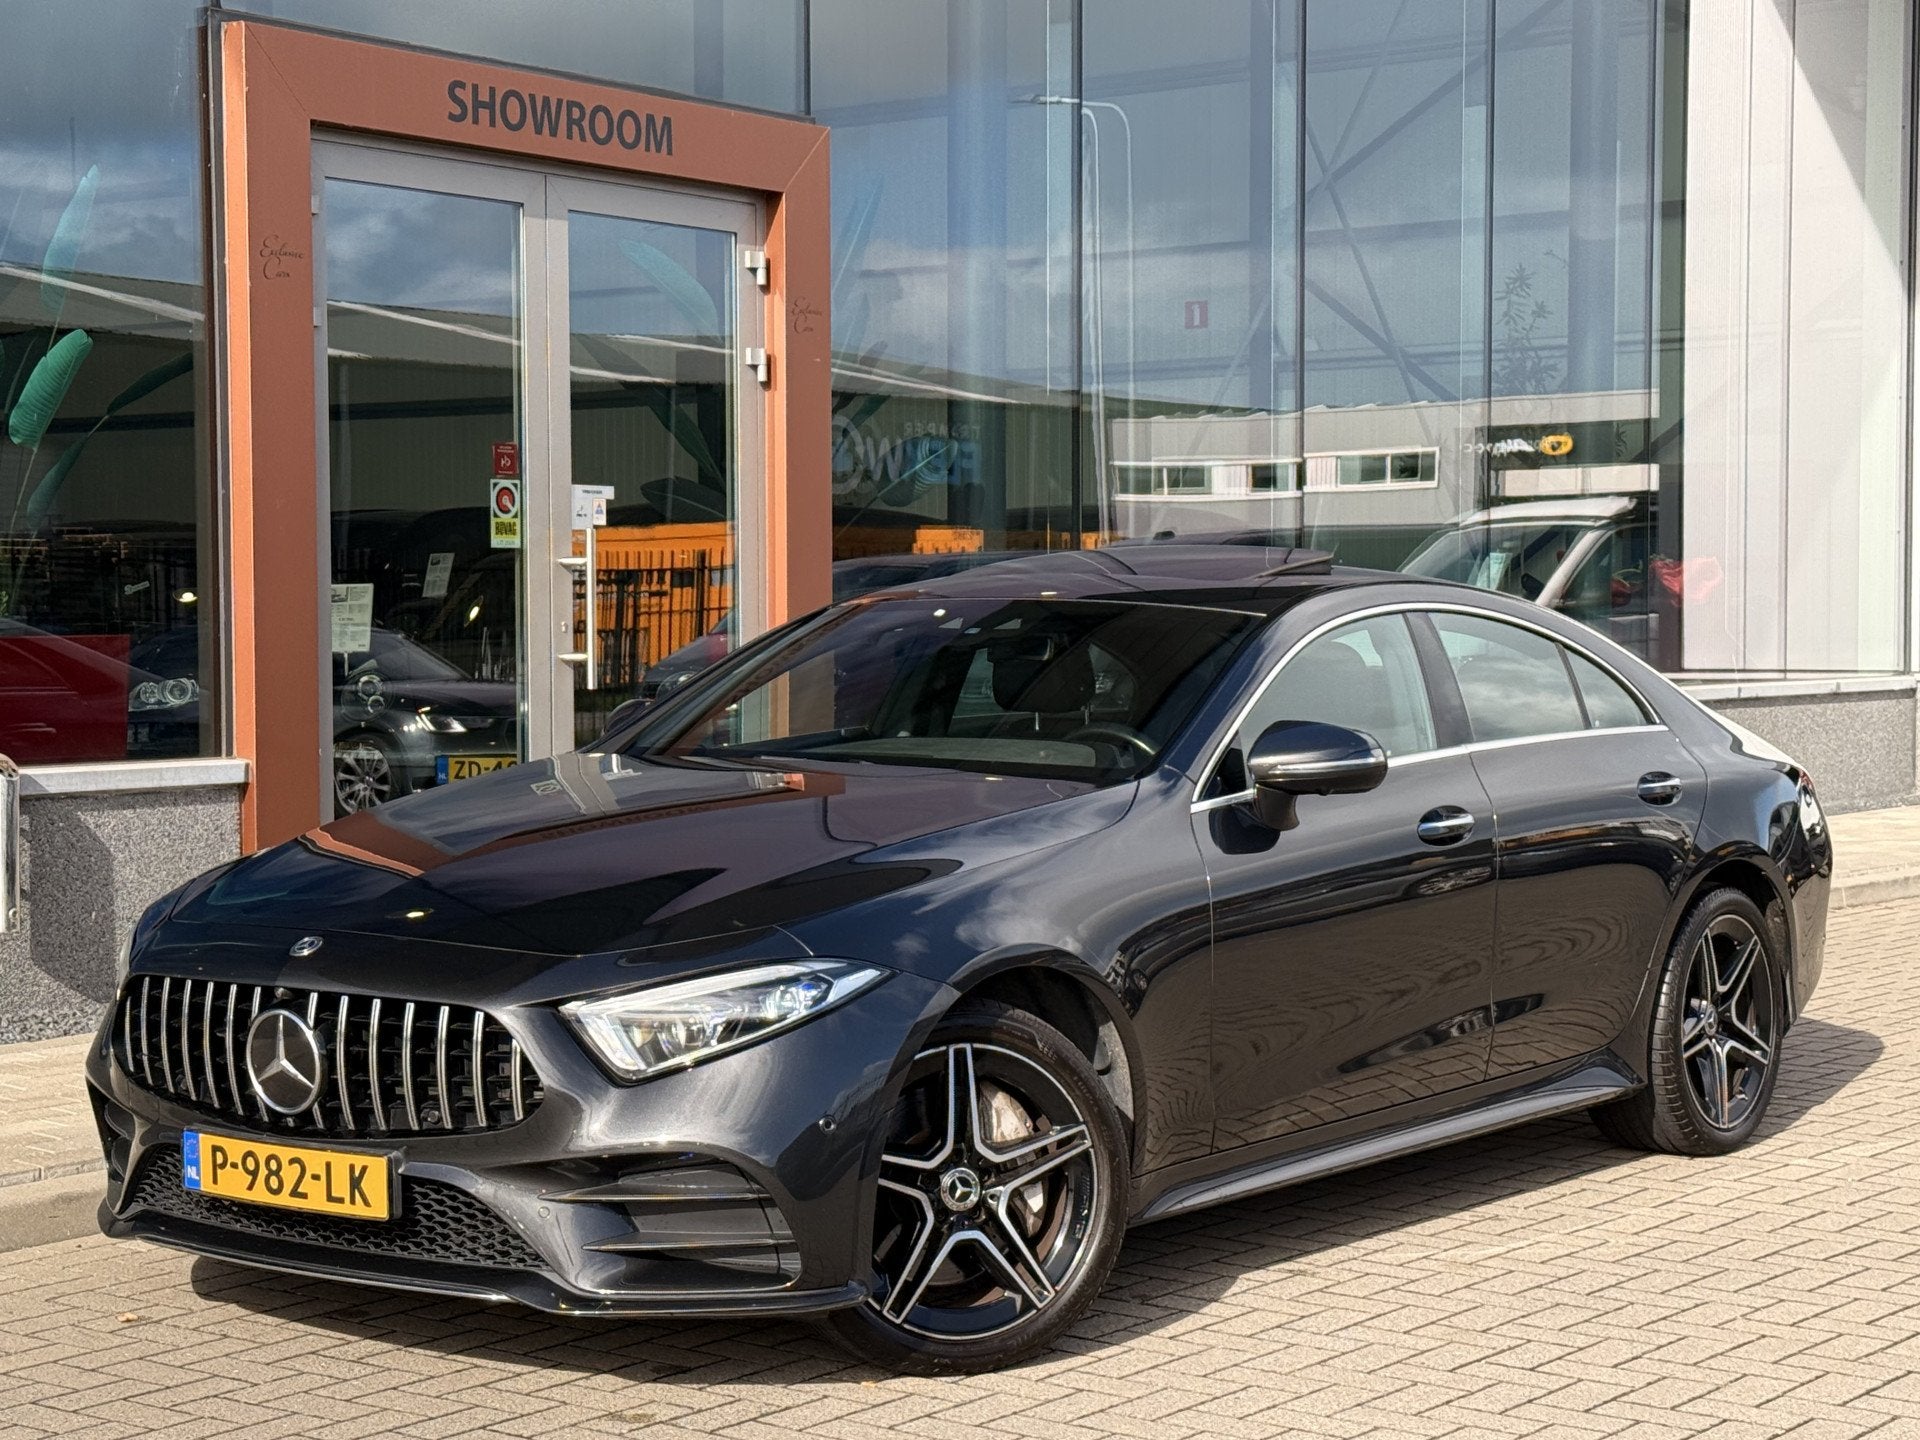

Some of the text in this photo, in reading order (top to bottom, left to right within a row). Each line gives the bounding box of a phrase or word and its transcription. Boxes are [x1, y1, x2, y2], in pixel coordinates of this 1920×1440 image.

[447, 79, 674, 156] SHOWROOM
[494, 521, 517, 537] BOVAG
[187, 1165, 200, 1181] NL
[210, 1144, 372, 1209] P-982-LK
